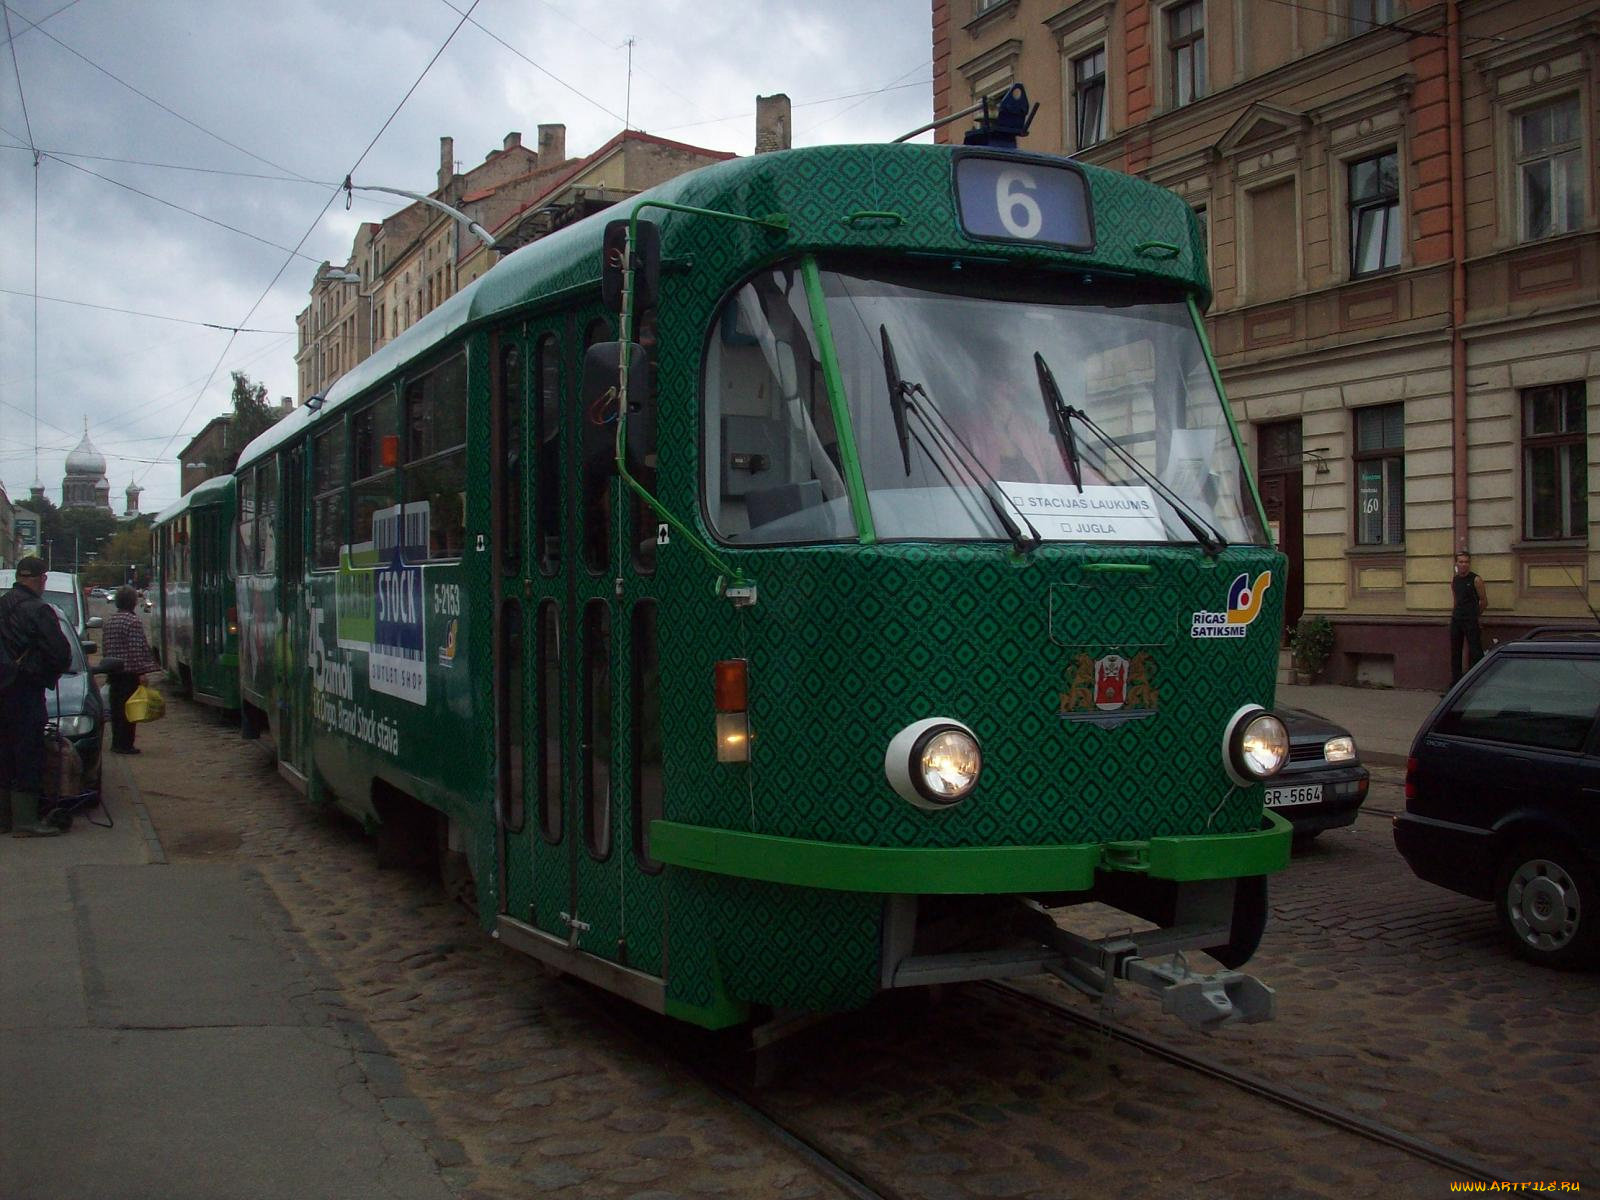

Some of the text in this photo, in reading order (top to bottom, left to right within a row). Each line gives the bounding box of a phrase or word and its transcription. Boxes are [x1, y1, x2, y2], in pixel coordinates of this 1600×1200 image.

[996, 169, 1042, 239] 6
[1029, 497, 1150, 511] STACIJAS LAUKUMS
[1076, 523, 1116, 534] JUGLA
[378, 569, 416, 624] STOCK
[434, 583, 460, 617] 5-2153
[1193, 610, 1226, 624] RĪGAS
[1192, 626, 1245, 637] SATIKSME
[372, 664, 424, 692] OUTLET SHOP
[357, 706, 376, 745] Stock
